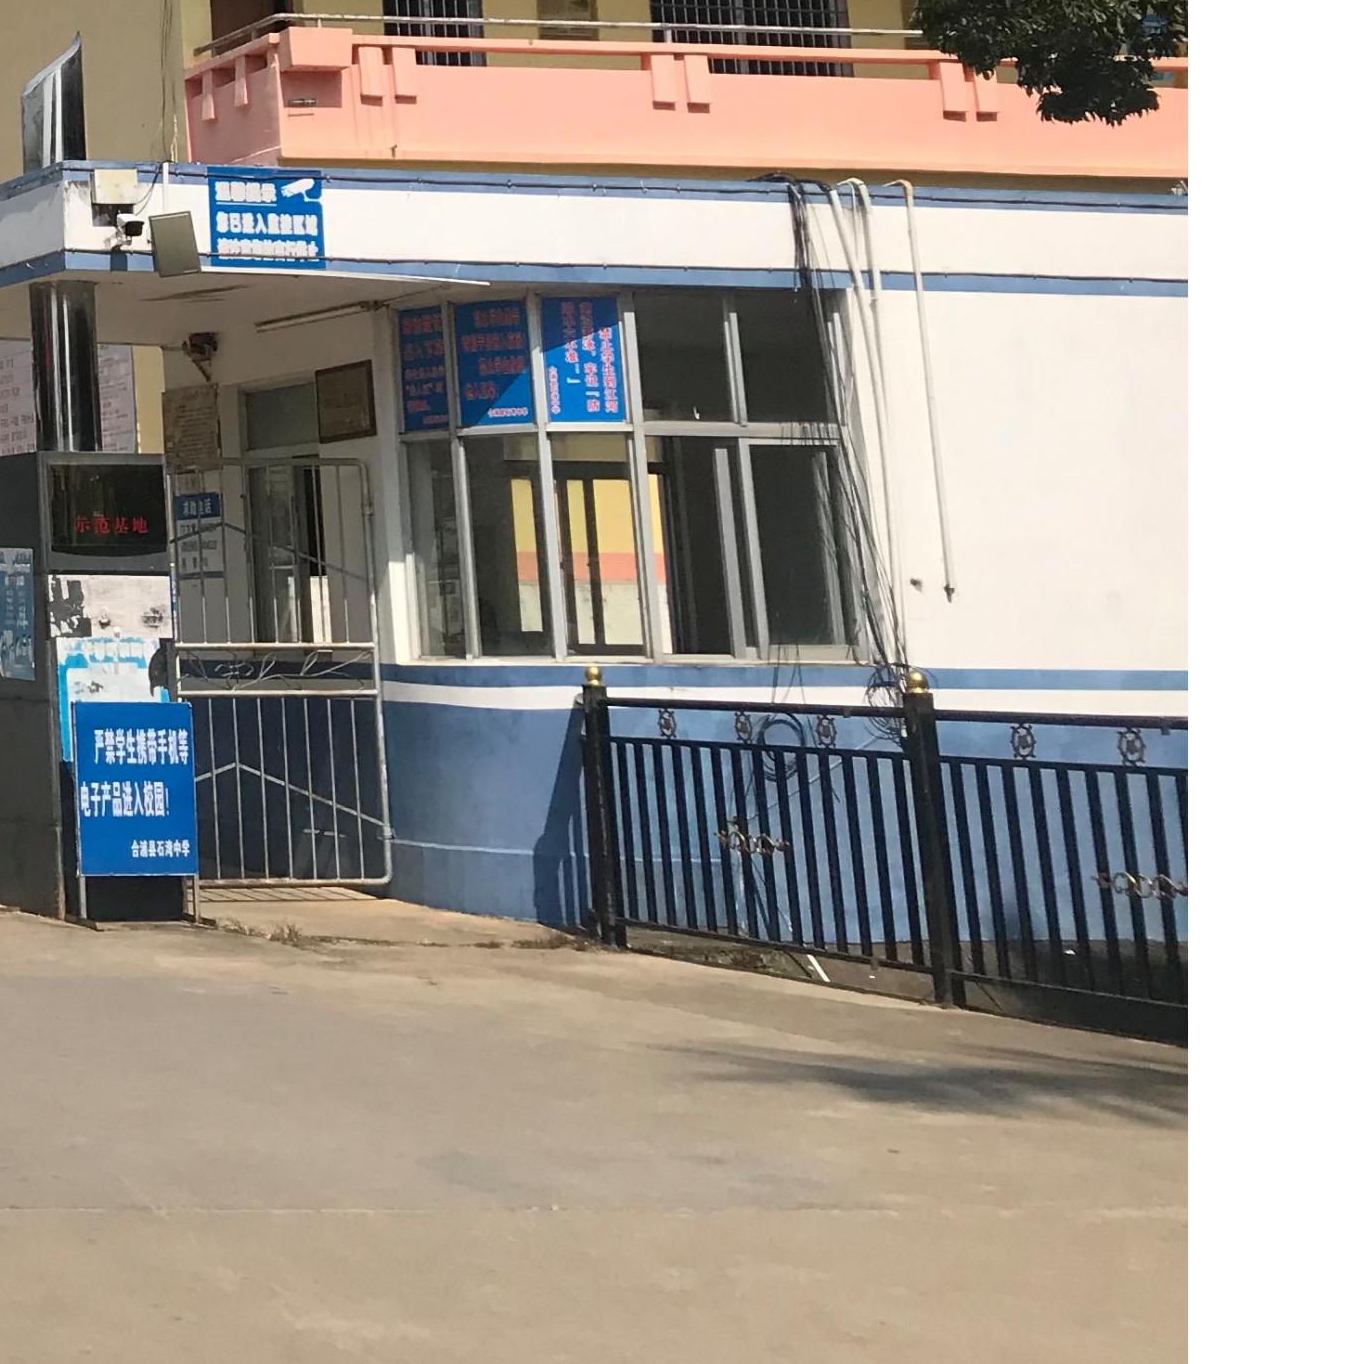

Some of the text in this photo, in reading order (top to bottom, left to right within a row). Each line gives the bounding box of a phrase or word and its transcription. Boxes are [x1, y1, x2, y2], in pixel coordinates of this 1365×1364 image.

[74, 516, 149, 535] 示范基地
[93, 728, 189, 766] 严禁学生携带手机等
[131, 839, 191, 859] 合浦县石湾中学
